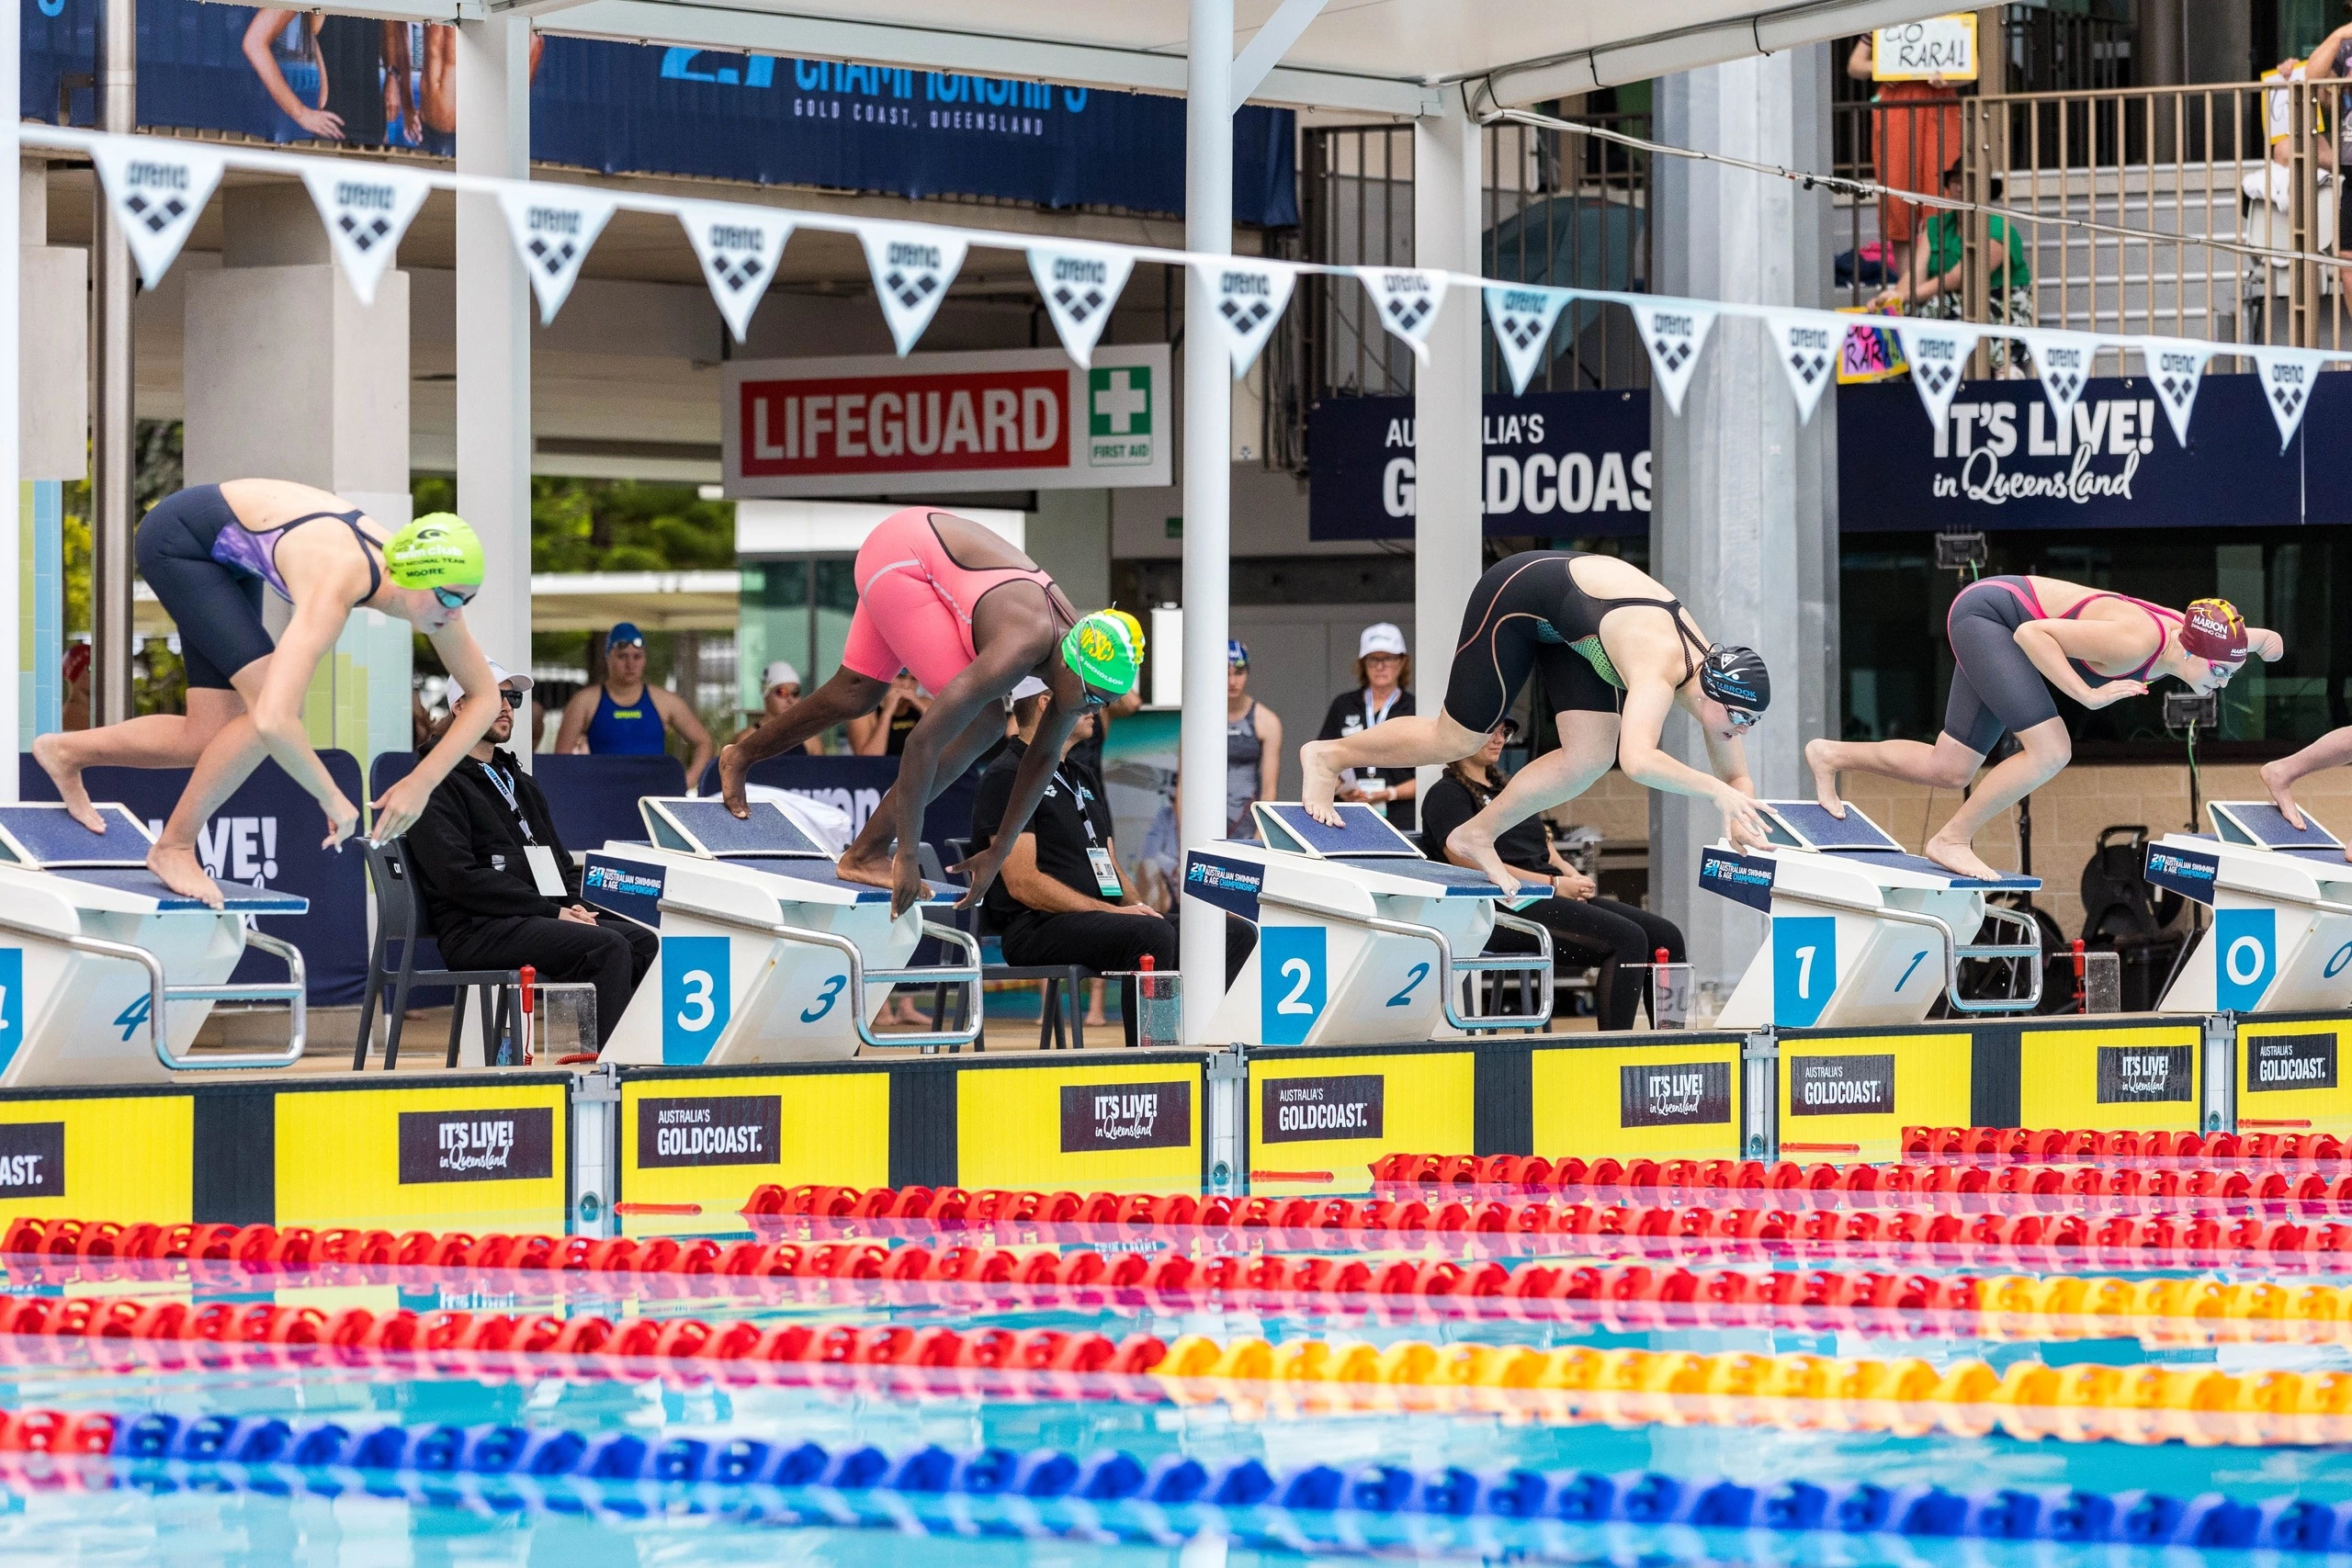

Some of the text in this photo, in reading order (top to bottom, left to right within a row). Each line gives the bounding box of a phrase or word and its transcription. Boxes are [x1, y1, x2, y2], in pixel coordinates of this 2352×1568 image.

[1899, 40, 1964, 68] RARA!
[793, 97, 1045, 138] GOLD COAST, QUEENSLAND
[1655, 313, 1692, 337] arena
[1791, 327, 1828, 349] arena
[1918, 339, 1955, 360] arena
[2047, 347, 2080, 367] arena
[2162, 353, 2195, 375] arena
[2273, 364, 2303, 384] arena
[753, 387, 1059, 459] LIFEGUARD
[1385, 413, 1544, 447] AULIA'S
[1933, 399, 2154, 457] IT'S LIVE!
[1093, 444, 1148, 459] FIRST AID
[1383, 450, 1652, 517] GDCOAS
[1933, 442, 2140, 505] in Queensland
[406, 568, 446, 578] MOORE
[2192, 615, 2228, 634] MARION
[2215, 631, 2227, 639] CLUB
[1084, 660, 1124, 686] NICHOLSON
[588, 865, 605, 877] 20
[1204, 868, 1234, 880] AUSTRALIAN
[1235, 874, 1260, 886] SWIMMING
[1719, 863, 1747, 874] AUSTRALIAN
[1747, 868, 1771, 879] SWIMMING
[2165, 859, 2215, 874] AUSTRALIAN SWIMMING
[2177, 867, 2212, 880] CHAMPIONSHIPS
[586, 875, 603, 886] 23
[604, 872, 662, 888] AUSTRALIAN SWIMMING
[608, 882, 618, 890] AGE
[618, 882, 659, 897] CHAMPIONSHIPS
[1219, 878, 1257, 892] CHAMPIONSHIPS
[1733, 874, 1770, 886] CHAMPIONSHIPS
[1795, 945, 1816, 999] 1
[1894, 950, 1928, 992] 1
[1277, 958, 1313, 1014] 2
[1385, 962, 1430, 1007] 2
[677, 969, 715, 1032] 3
[800, 974, 847, 1023] 3
[113, 992, 152, 1042] 4
[2260, 1045, 2293, 1056] AUSTRALIA'S
[1805, 1066, 1843, 1077] AUSTRALIA'S
[2122, 1055, 2168, 1077] IT'S LIVE!
[2259, 1057, 2326, 1081] GOLDCOAST.
[1649, 1074, 1703, 1098] IT'S LIVE!
[1804, 1080, 1881, 1105] GOLDCOAST.
[2122, 1071, 2165, 1093] in Queensland
[1095, 1093, 1158, 1120] IT'S LIVE!
[1280, 1089, 1323, 1101] AUSTRALIA'S
[1650, 1090, 1700, 1116] in Queensland
[659, 1109, 711, 1123] AUSTRALIA'S
[1095, 1112, 1154, 1140] in Queensland
[1279, 1103, 1368, 1131] GOLDCOAST.
[439, 1121, 514, 1149] IT'S LIVE!
[657, 1126, 763, 1156] GOLDCOAST.
[439, 1143, 509, 1171] in Queensland
